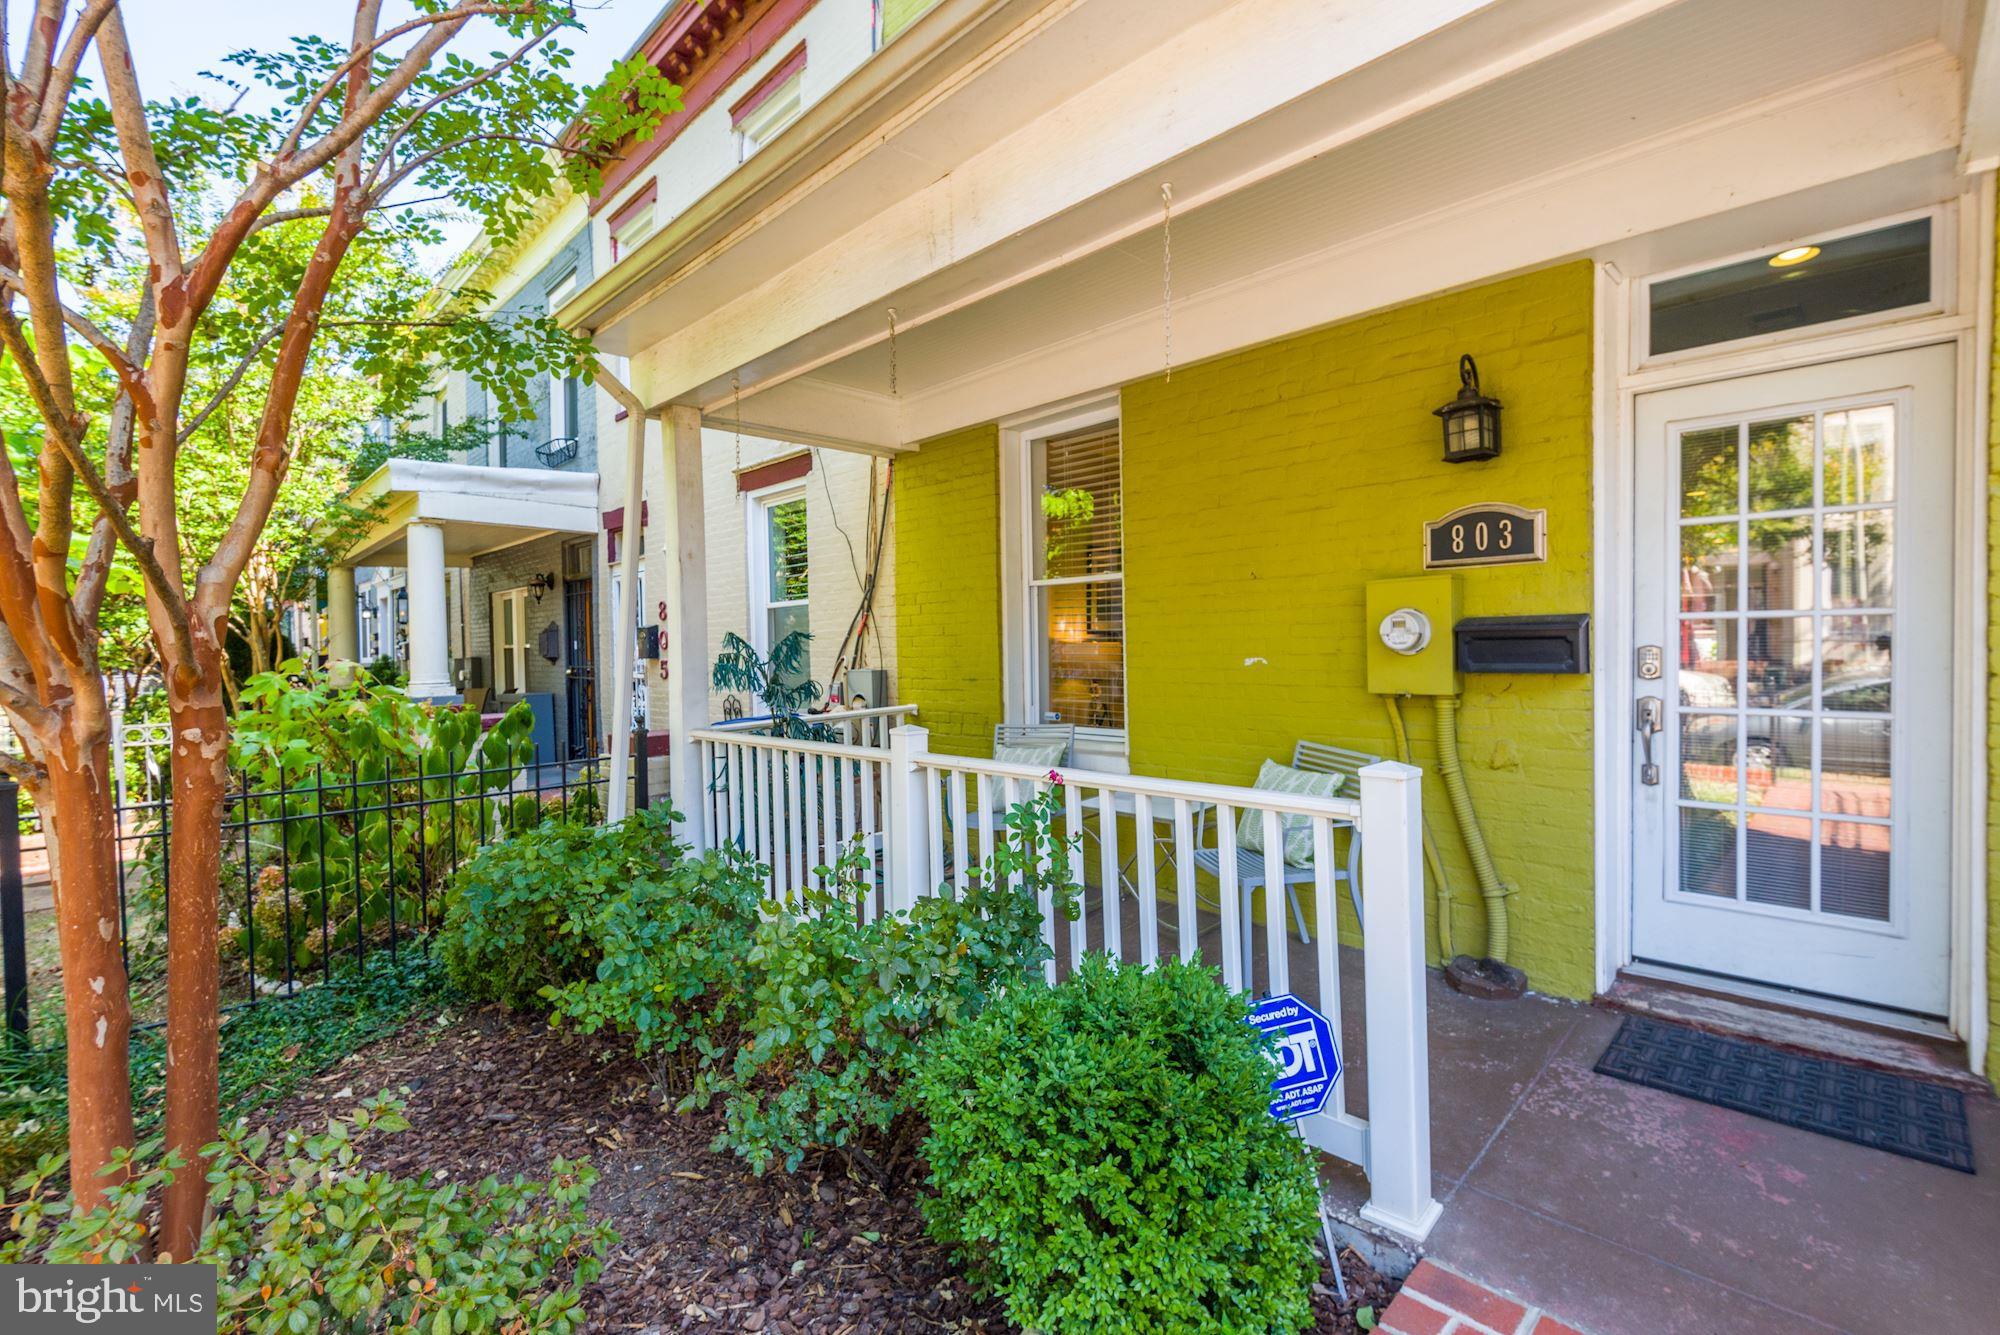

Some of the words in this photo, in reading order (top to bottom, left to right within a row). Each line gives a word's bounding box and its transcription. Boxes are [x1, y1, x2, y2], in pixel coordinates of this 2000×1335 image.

[1451, 519, 1513, 553] 803
[658, 601, 669, 680] 805
[1248, 1006, 1288, 1025] Secured
[1286, 1005, 1299, 1017] by
